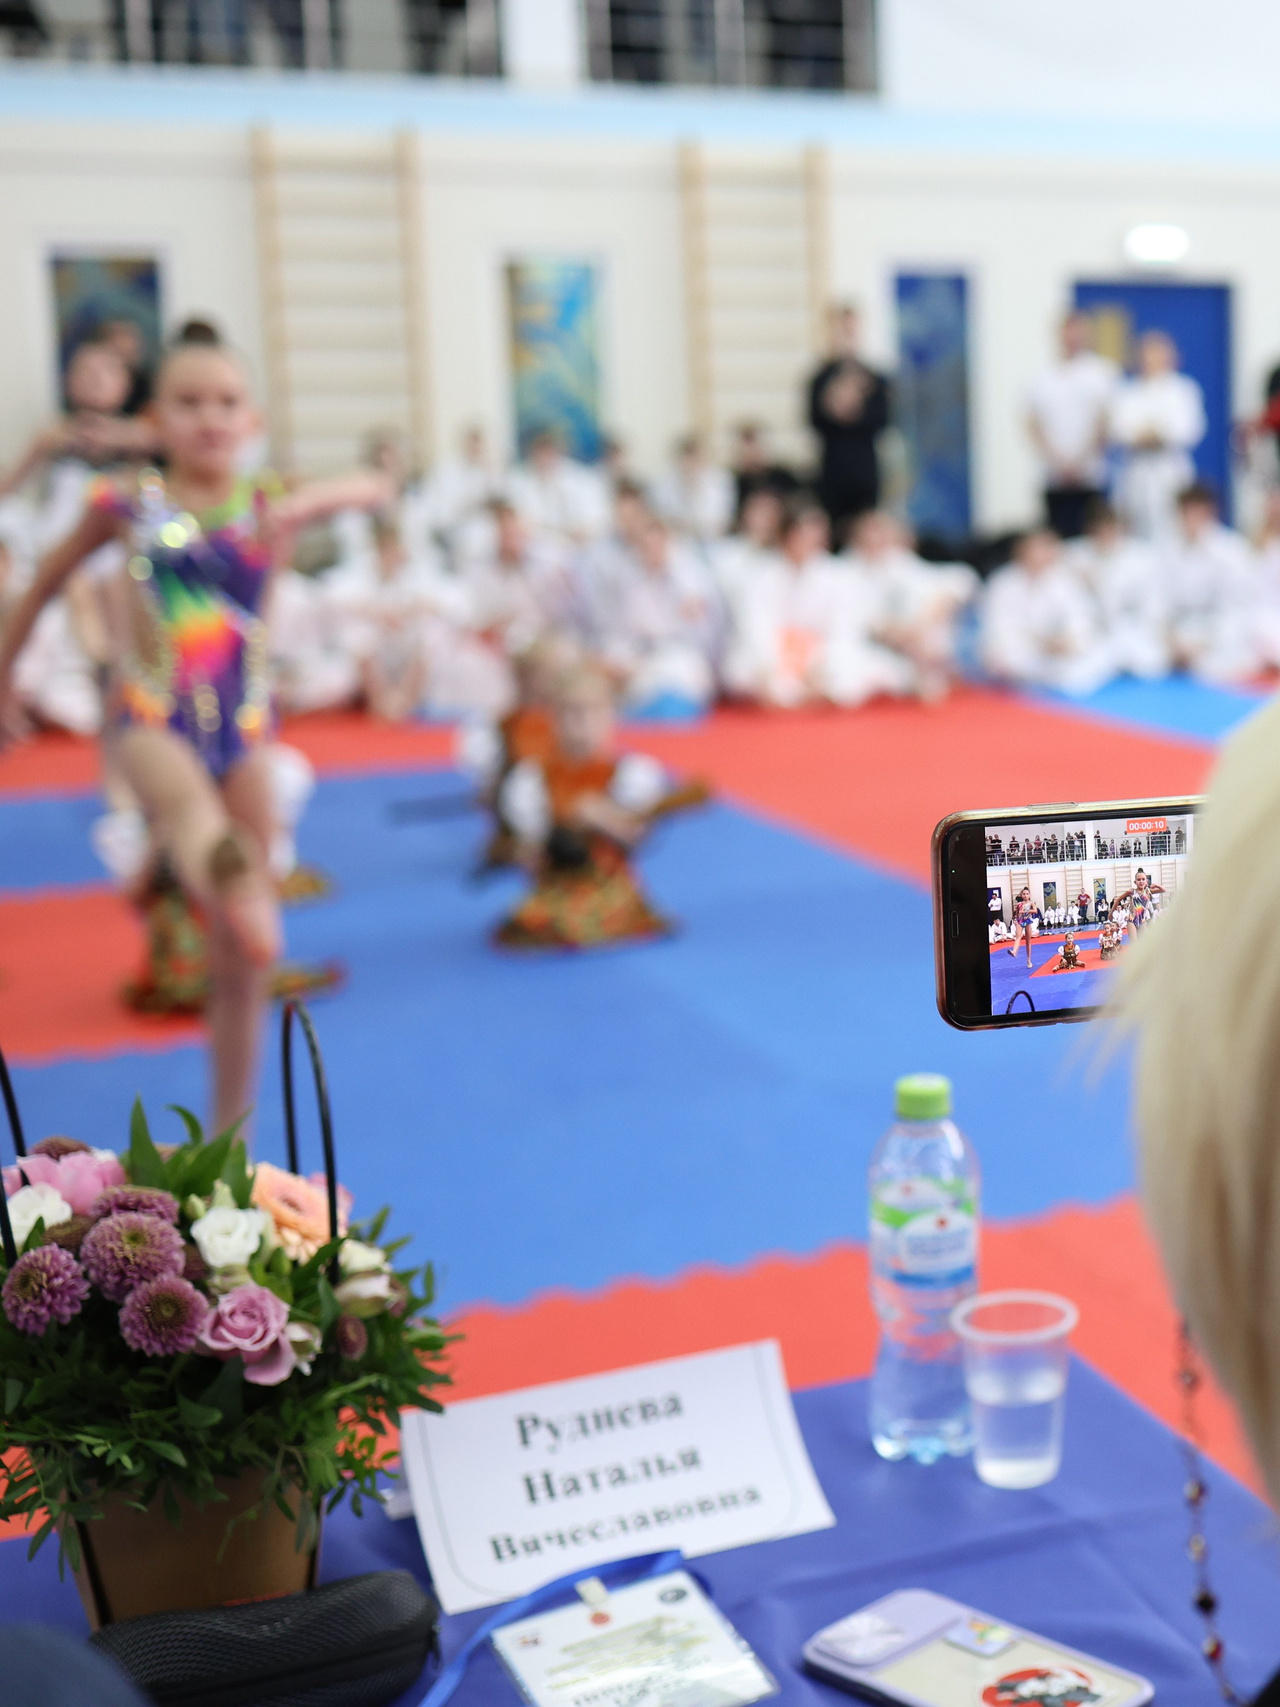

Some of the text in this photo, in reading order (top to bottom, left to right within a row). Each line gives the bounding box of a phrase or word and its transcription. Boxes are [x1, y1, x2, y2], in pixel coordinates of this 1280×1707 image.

[1129, 821, 1164, 831] 00:00:10
[523, 1447, 702, 1505] Наталья
[488, 1487, 762, 1562] Вячеславовна
